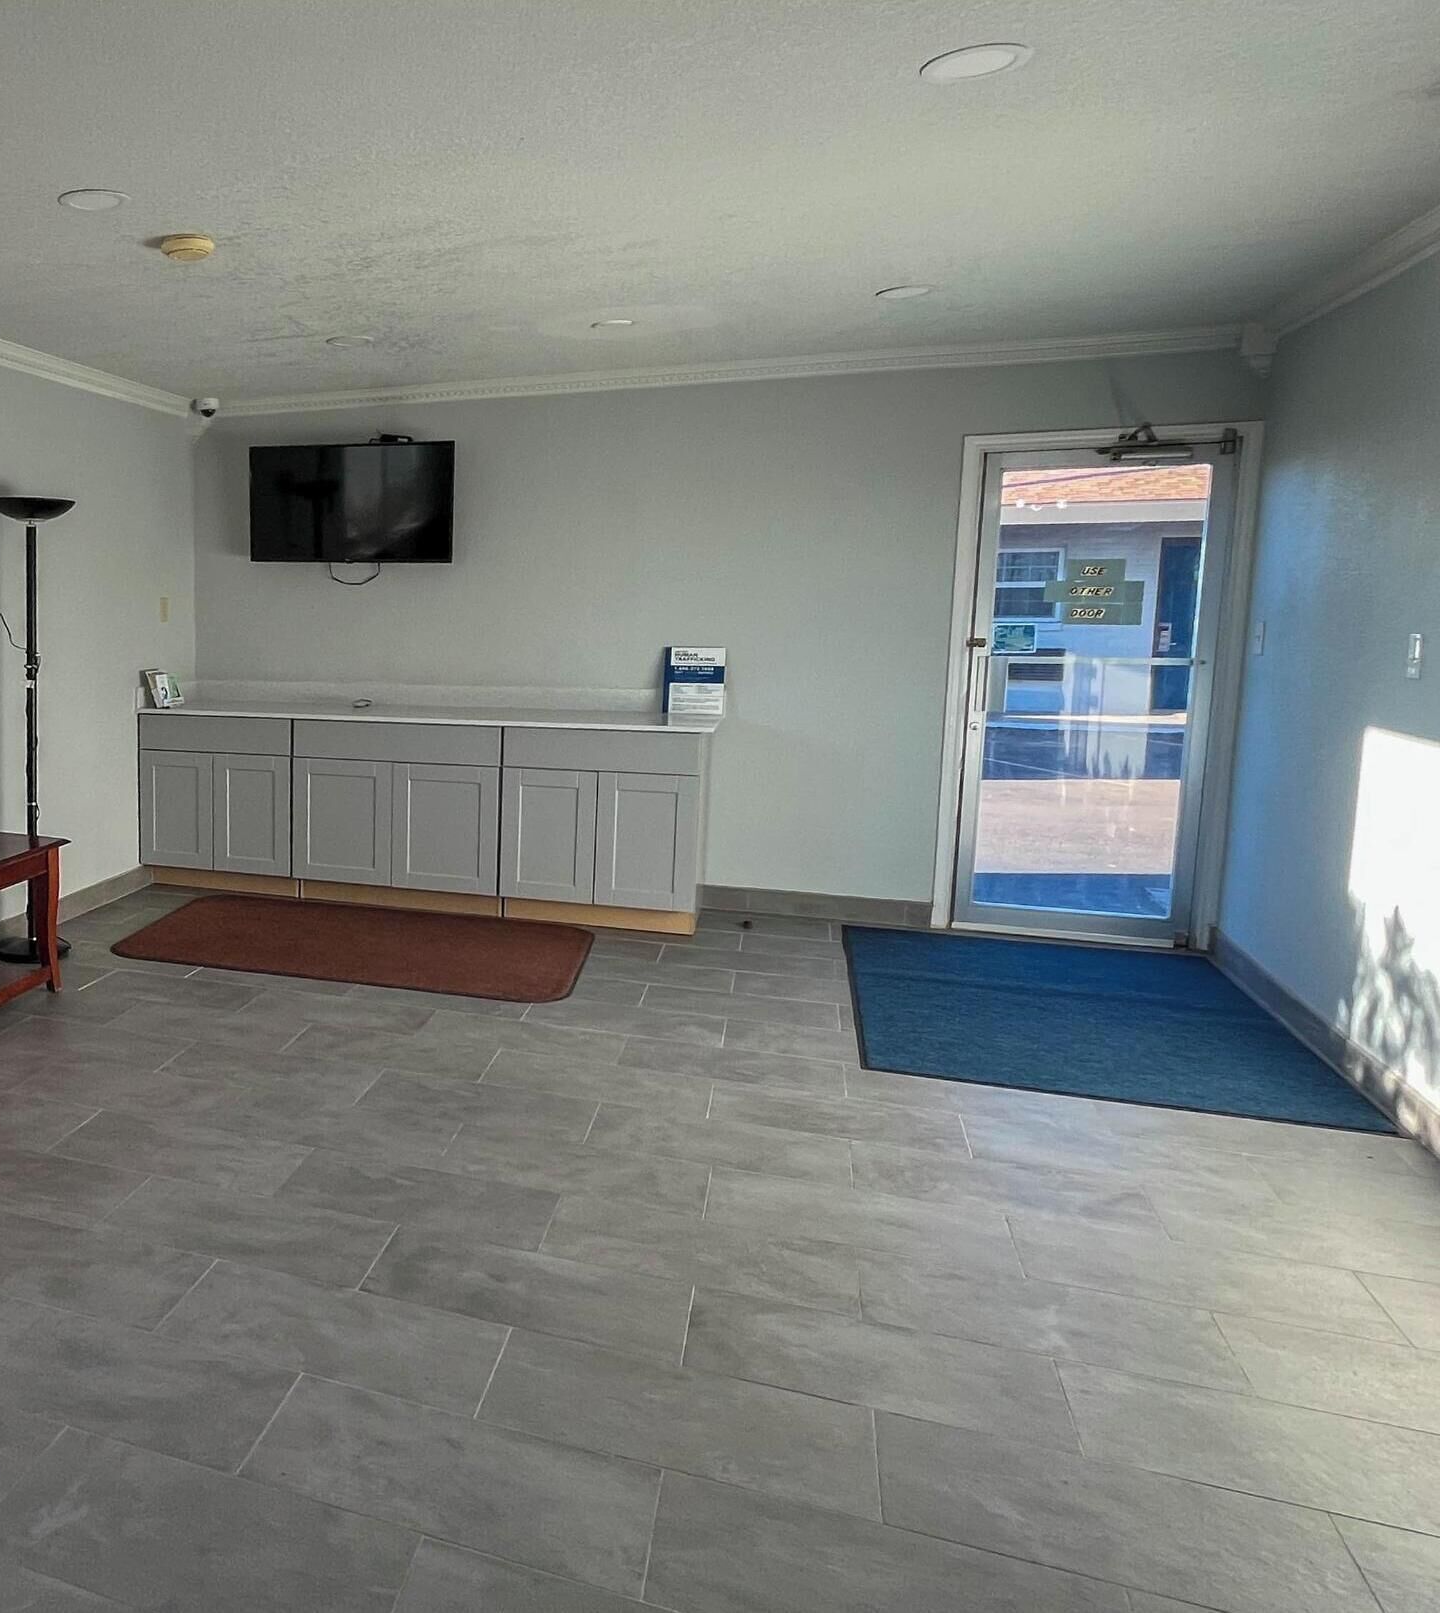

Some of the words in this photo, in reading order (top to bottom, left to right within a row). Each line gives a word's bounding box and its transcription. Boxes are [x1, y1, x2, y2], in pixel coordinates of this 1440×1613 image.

[1081, 567, 1106, 576] USE
[1070, 586, 1114, 596] OTHER
[1070, 609, 1105, 618] DOOR
